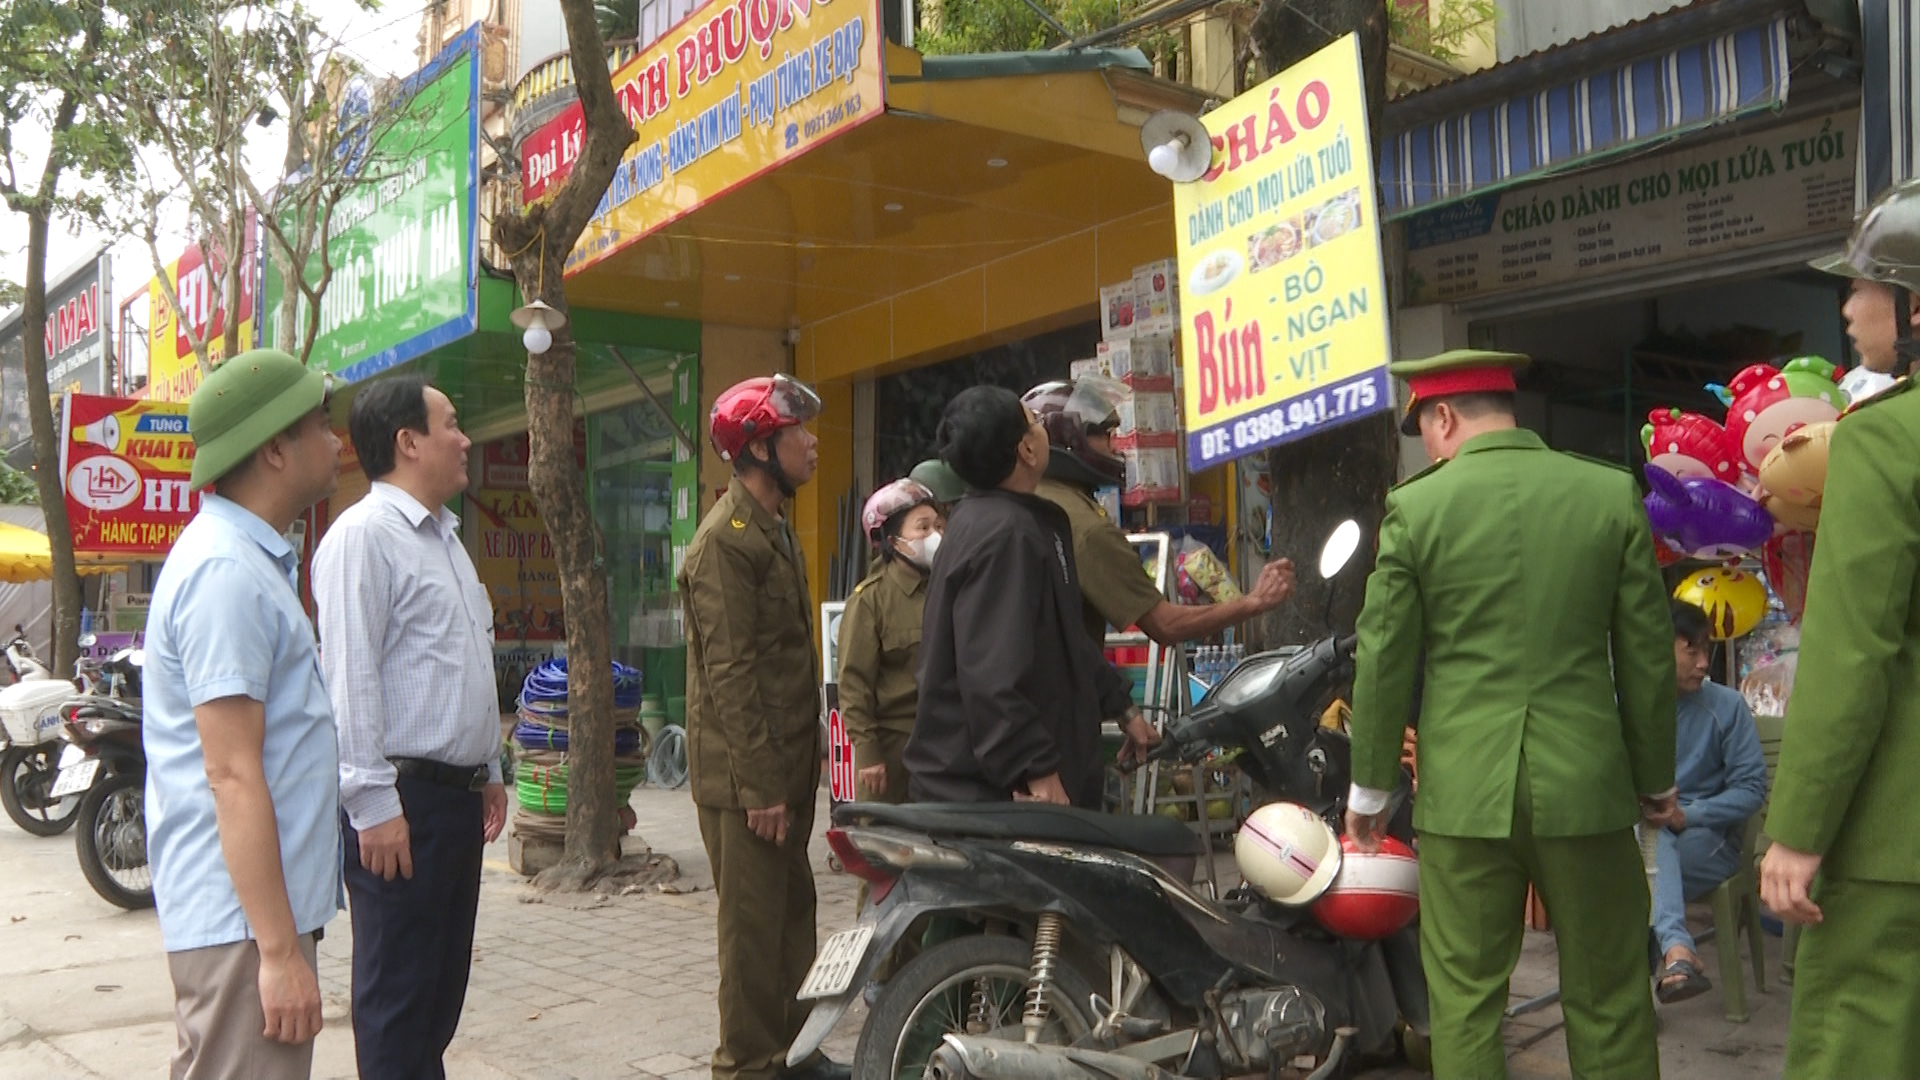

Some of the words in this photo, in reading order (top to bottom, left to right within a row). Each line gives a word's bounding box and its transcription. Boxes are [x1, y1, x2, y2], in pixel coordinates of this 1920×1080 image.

[668, 120, 698, 175] HÀNG
[699, 104, 721, 158] KIM
[720, 81, 742, 145] KHÍ
[749, 70, 775, 128] PHỤ
[776, 50, 812, 112] TÙNG
[813, 35, 833, 92] XE
[833, 16, 863, 84] ĐẠP
[528, 138, 558, 188] Đại
[561, 117, 583, 166] Lý
[1502, 195, 1556, 232] CHÁO
[1562, 185, 1621, 221] DÀNH
[1627, 171, 1672, 205] CHO
[1677, 160, 1720, 197] MỌI
[1727, 145, 1776, 183] LỨA
[1782, 117, 1846, 171] TUỔI
[1189, 204, 1224, 246] DÀNH
[1227, 186, 1254, 227] CHO
[1257, 169, 1285, 214] MỌI
[1287, 154, 1316, 199] LỨA
[58, 281, 98, 354] MAI
[313, 239, 365, 340] HUỐC
[1284, 260, 1324, 303] BÒ
[1287, 287, 1368, 342] NGAN
[1194, 297, 1267, 416] Bún
[1289, 342, 1331, 382] VỊT
[126, 438, 174, 458] KHAI
[1201, 427, 1232, 460] ĐT:
[1233, 376, 1378, 449] 0388.941.775
[100, 517, 138, 544] HÀNG
[140, 523, 166, 549] TẠP
[483, 531, 502, 558] XE
